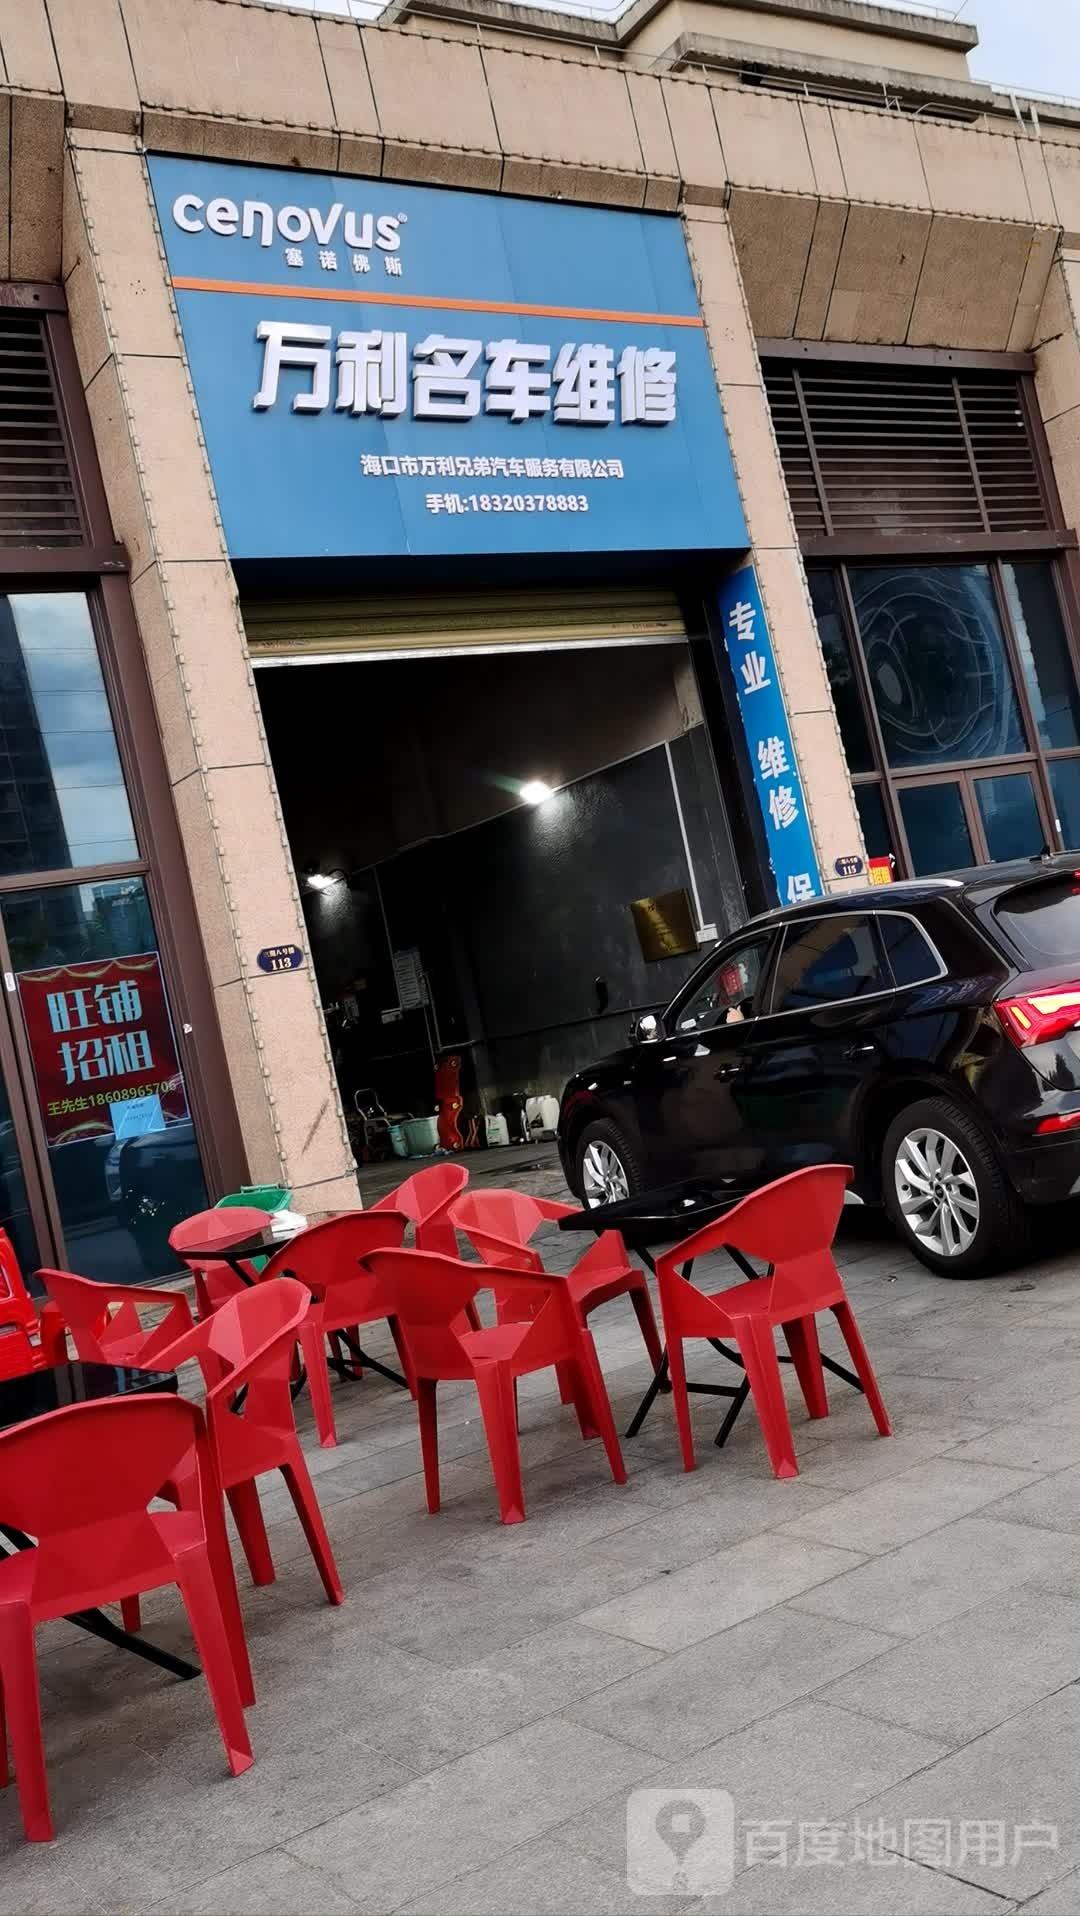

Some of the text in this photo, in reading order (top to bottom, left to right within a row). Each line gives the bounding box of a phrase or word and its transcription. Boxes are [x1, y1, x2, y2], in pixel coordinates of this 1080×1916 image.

[285, 248, 402, 277] 塞诺佛斯
[253, 320, 677, 425] 万利名车维修
[361, 454, 624, 478] 海口市万利兄弟汽车服务有限公司
[425, 493, 589, 514] 手机:18320378883
[728, 601, 771, 696] 专业
[757, 735, 798, 831] 维修
[272, 957, 292, 971] 113
[46, 980, 143, 1034] 旺铺
[57, 1030, 155, 1085] 招租
